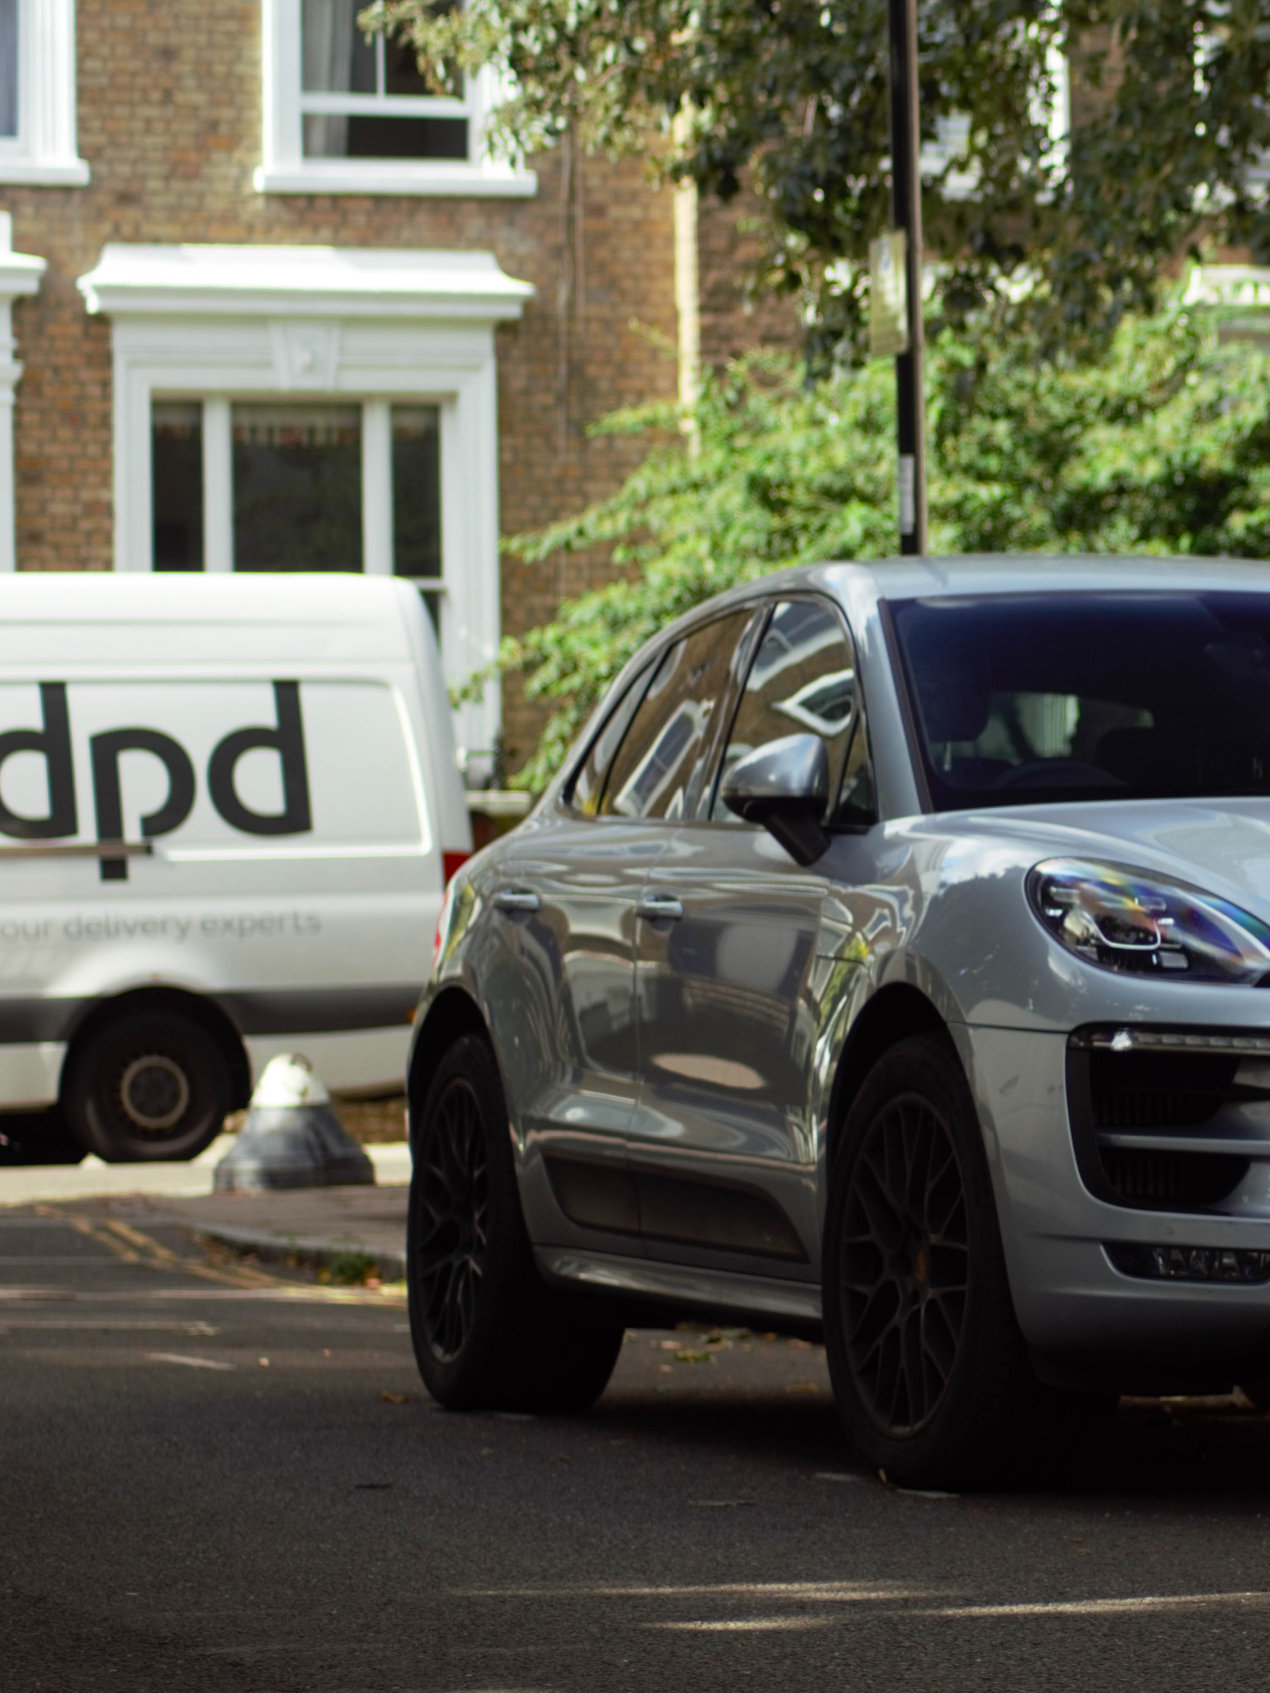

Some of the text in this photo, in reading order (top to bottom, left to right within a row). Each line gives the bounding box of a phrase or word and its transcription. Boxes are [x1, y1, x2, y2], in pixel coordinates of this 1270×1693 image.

[0, 680, 313, 881] dpd
[0, 910, 322, 943] our delivery experts
